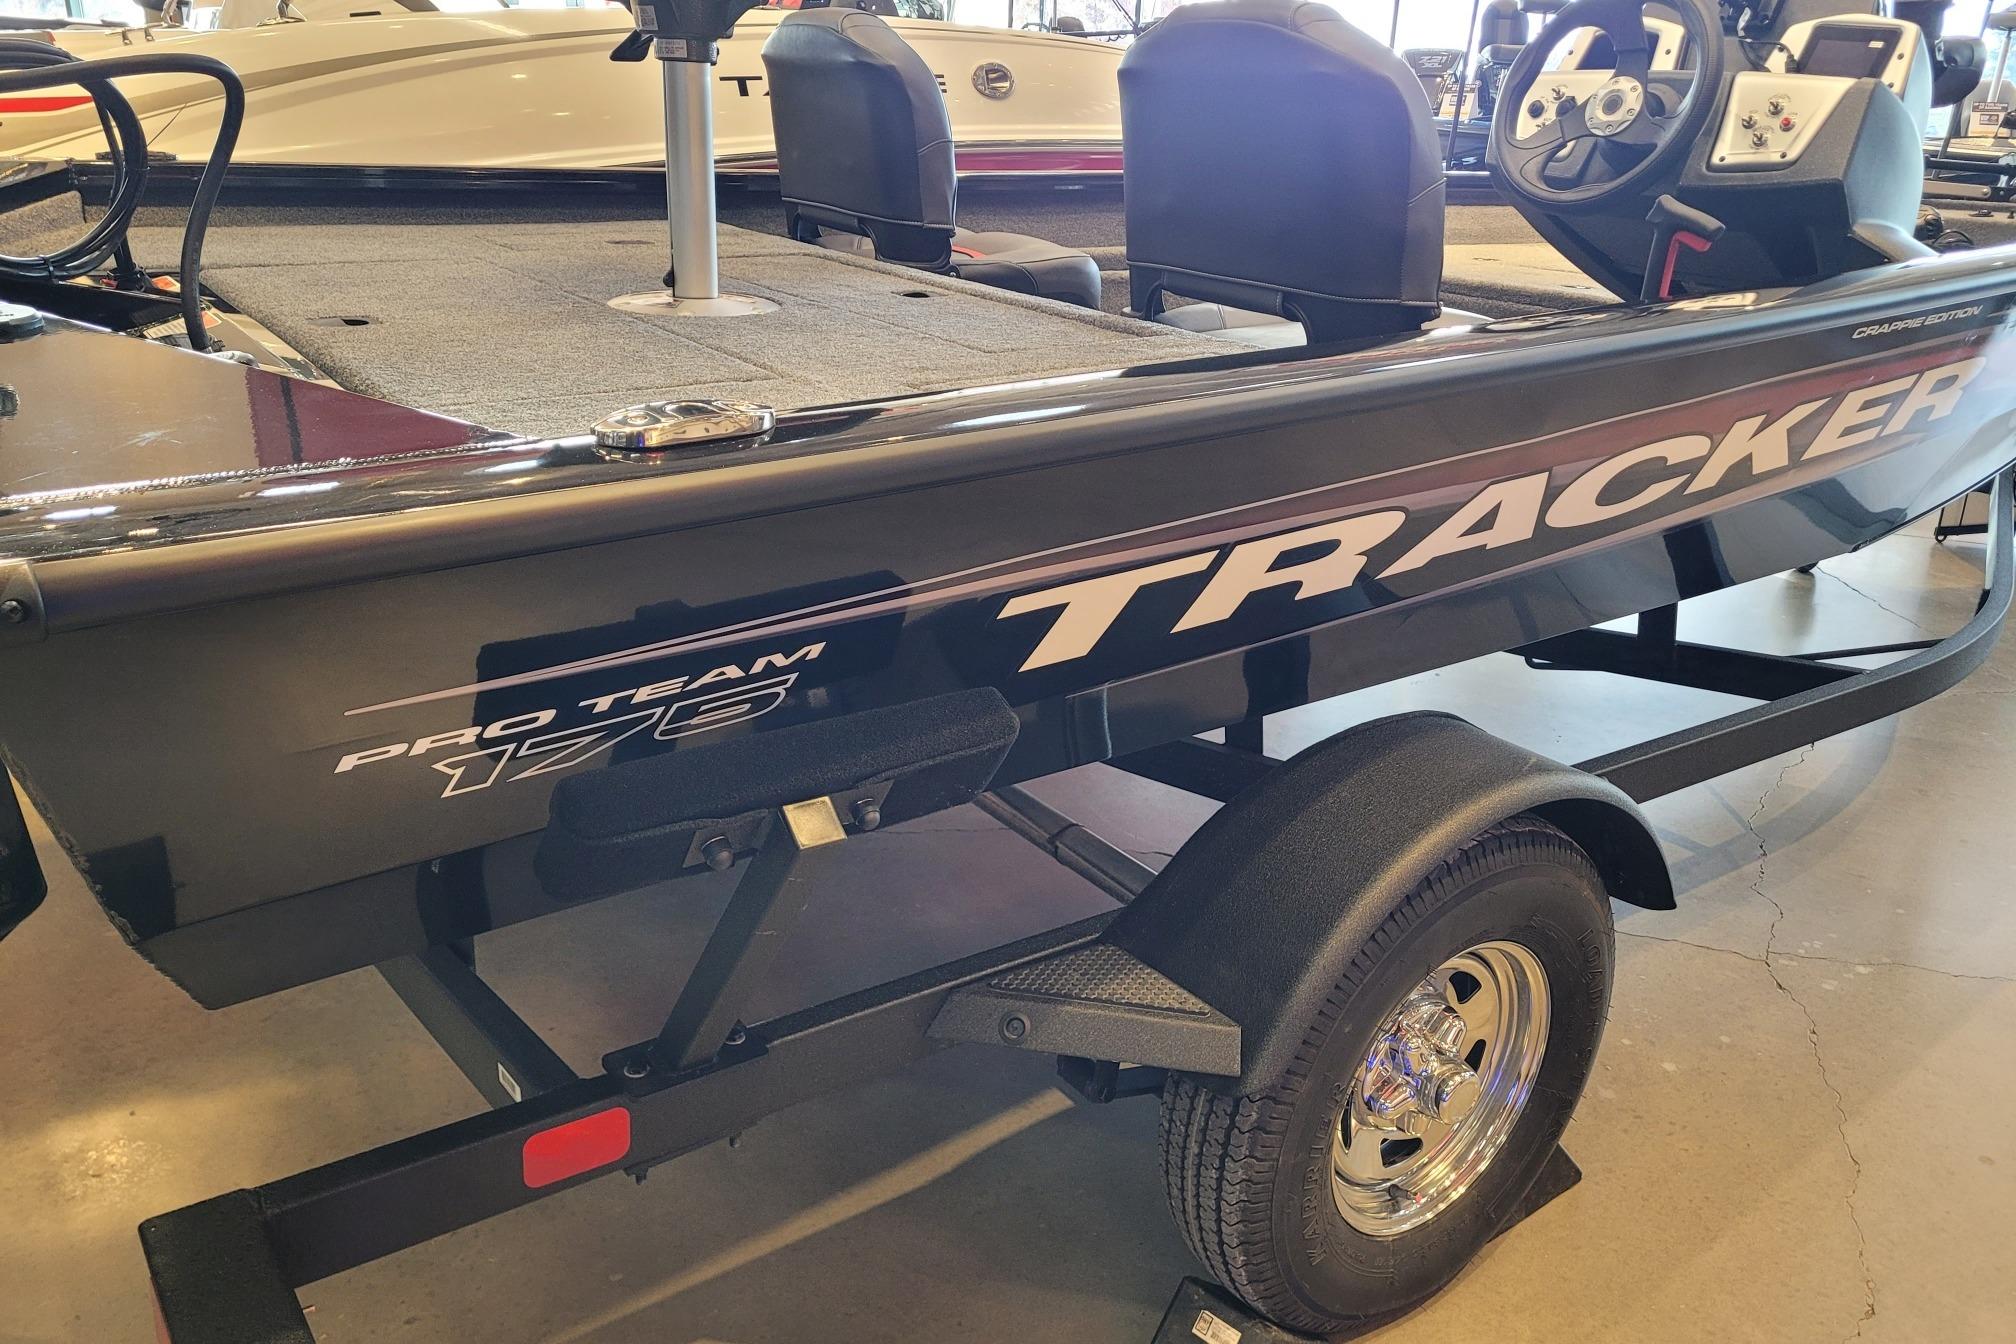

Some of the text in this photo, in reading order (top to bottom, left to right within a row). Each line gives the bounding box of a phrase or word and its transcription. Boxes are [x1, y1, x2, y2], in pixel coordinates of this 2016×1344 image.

[1851, 305, 1984, 339] CRAPPIE EDITION
[999, 356, 1987, 673] TRACKER
[334, 641, 827, 774] PRO TEAM
[431, 672, 800, 799] 175
